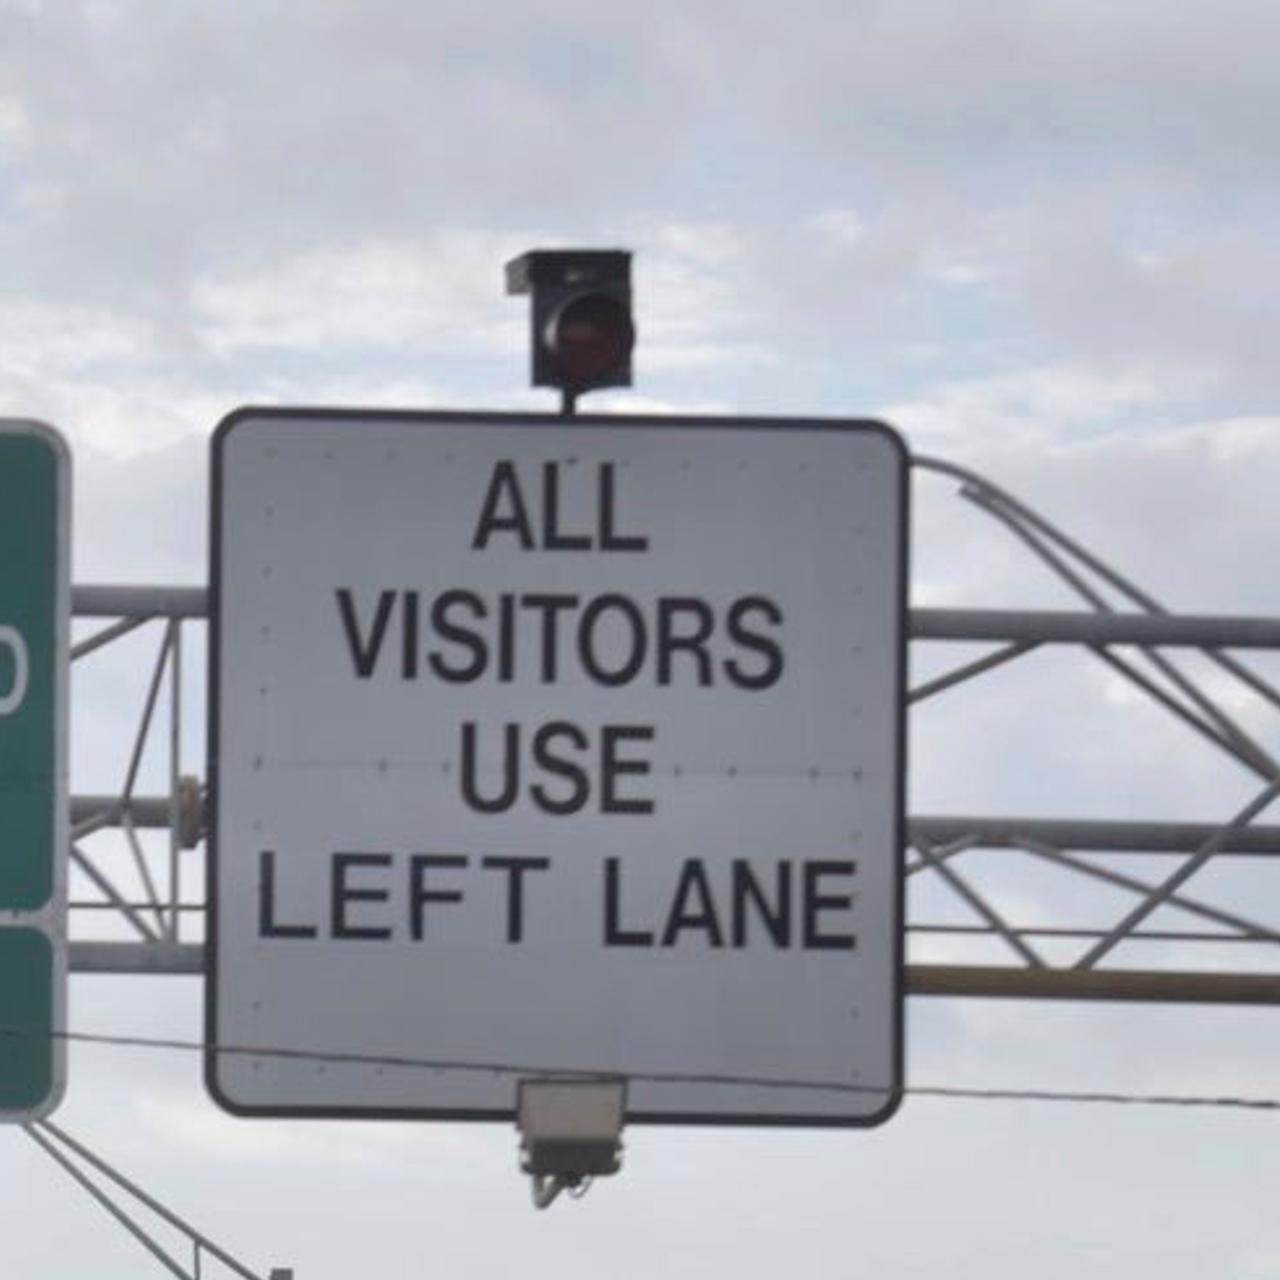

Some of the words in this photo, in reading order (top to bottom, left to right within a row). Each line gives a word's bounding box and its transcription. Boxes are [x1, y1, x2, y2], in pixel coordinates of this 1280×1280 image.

[471, 460, 649, 553] ALL
[336, 588, 786, 691] VISITORS
[460, 720, 656, 816] USE
[258, 851, 551, 945] LEFT
[603, 858, 857, 951] LANE
